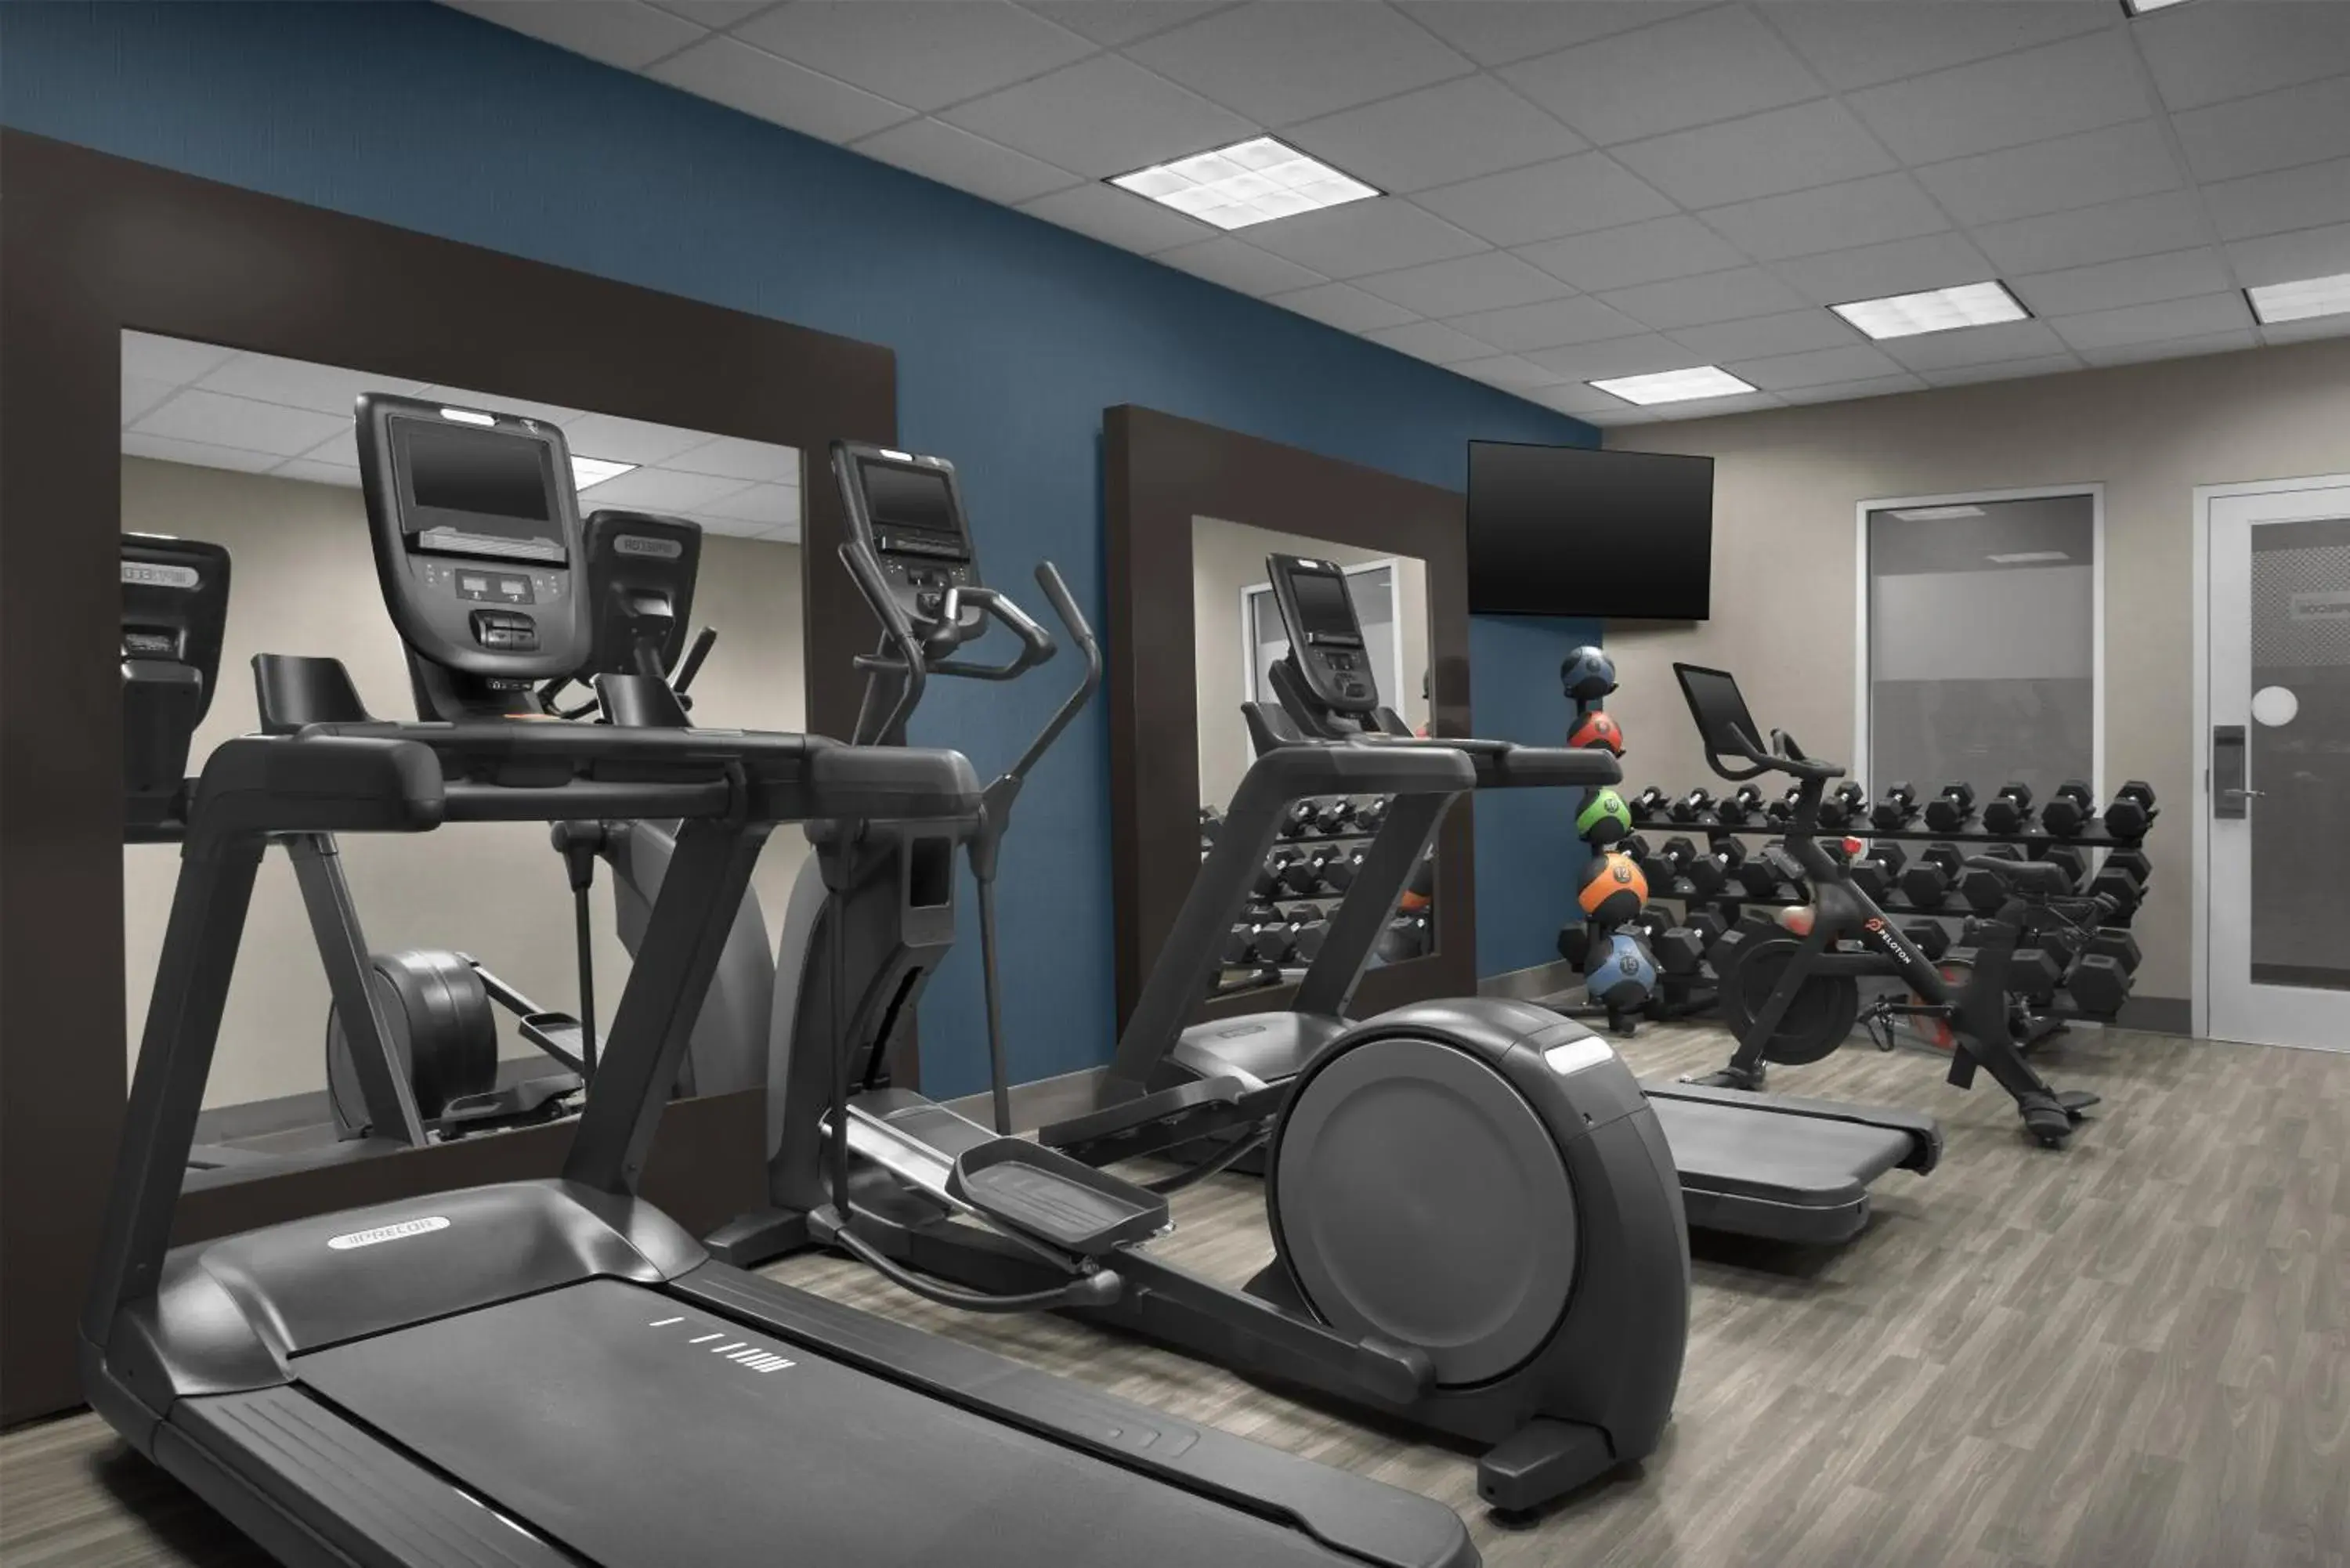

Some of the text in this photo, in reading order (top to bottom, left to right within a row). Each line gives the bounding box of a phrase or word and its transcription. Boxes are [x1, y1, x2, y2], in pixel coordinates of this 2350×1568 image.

[1616, 867, 1630, 878] 12
[1878, 930, 1911, 963] PELOTON
[1622, 958, 1636, 970] 15
[359, 1219, 434, 1244] PRECOR
